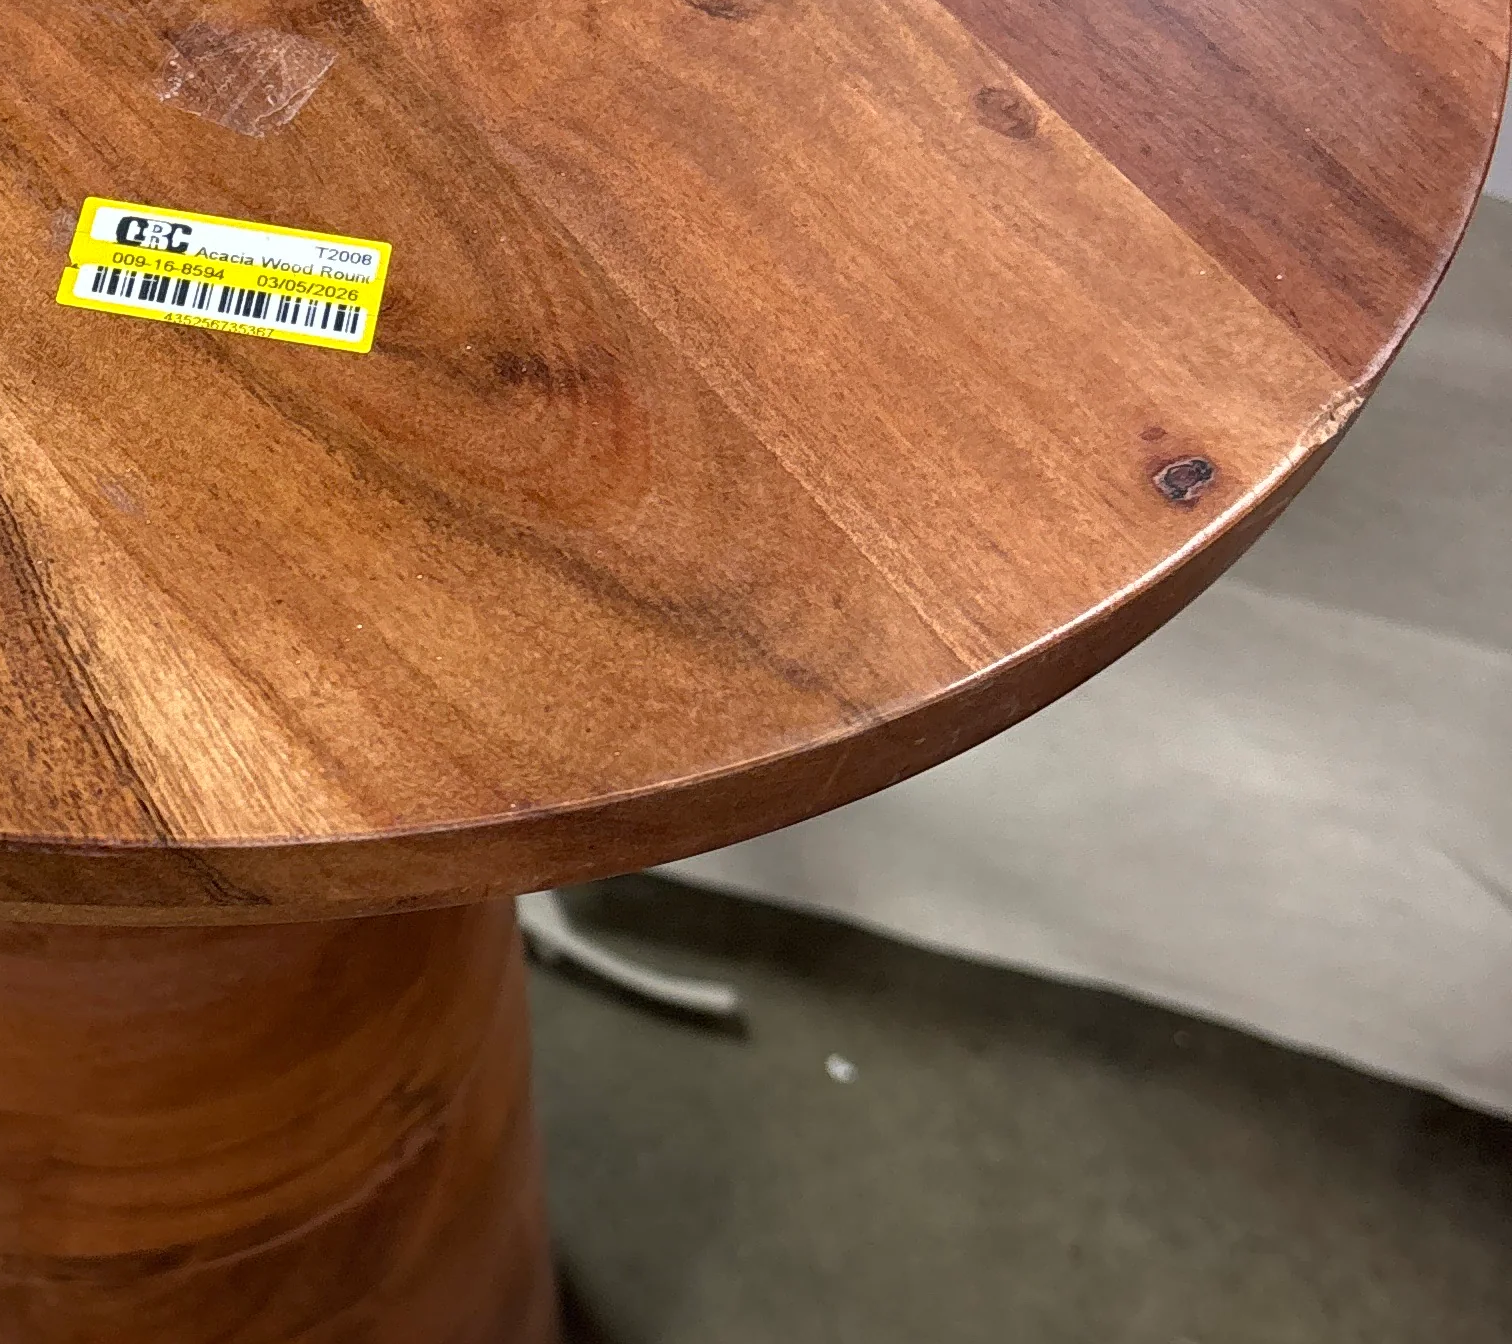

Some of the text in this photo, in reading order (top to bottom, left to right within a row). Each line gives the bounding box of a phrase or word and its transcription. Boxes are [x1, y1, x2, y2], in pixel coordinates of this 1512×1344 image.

[194, 246, 254, 267] Acacia
[261, 256, 314, 275] Wood
[315, 245, 373, 266] T2008
[112, 251, 360, 302] 009-16-8594 03/05/2026
